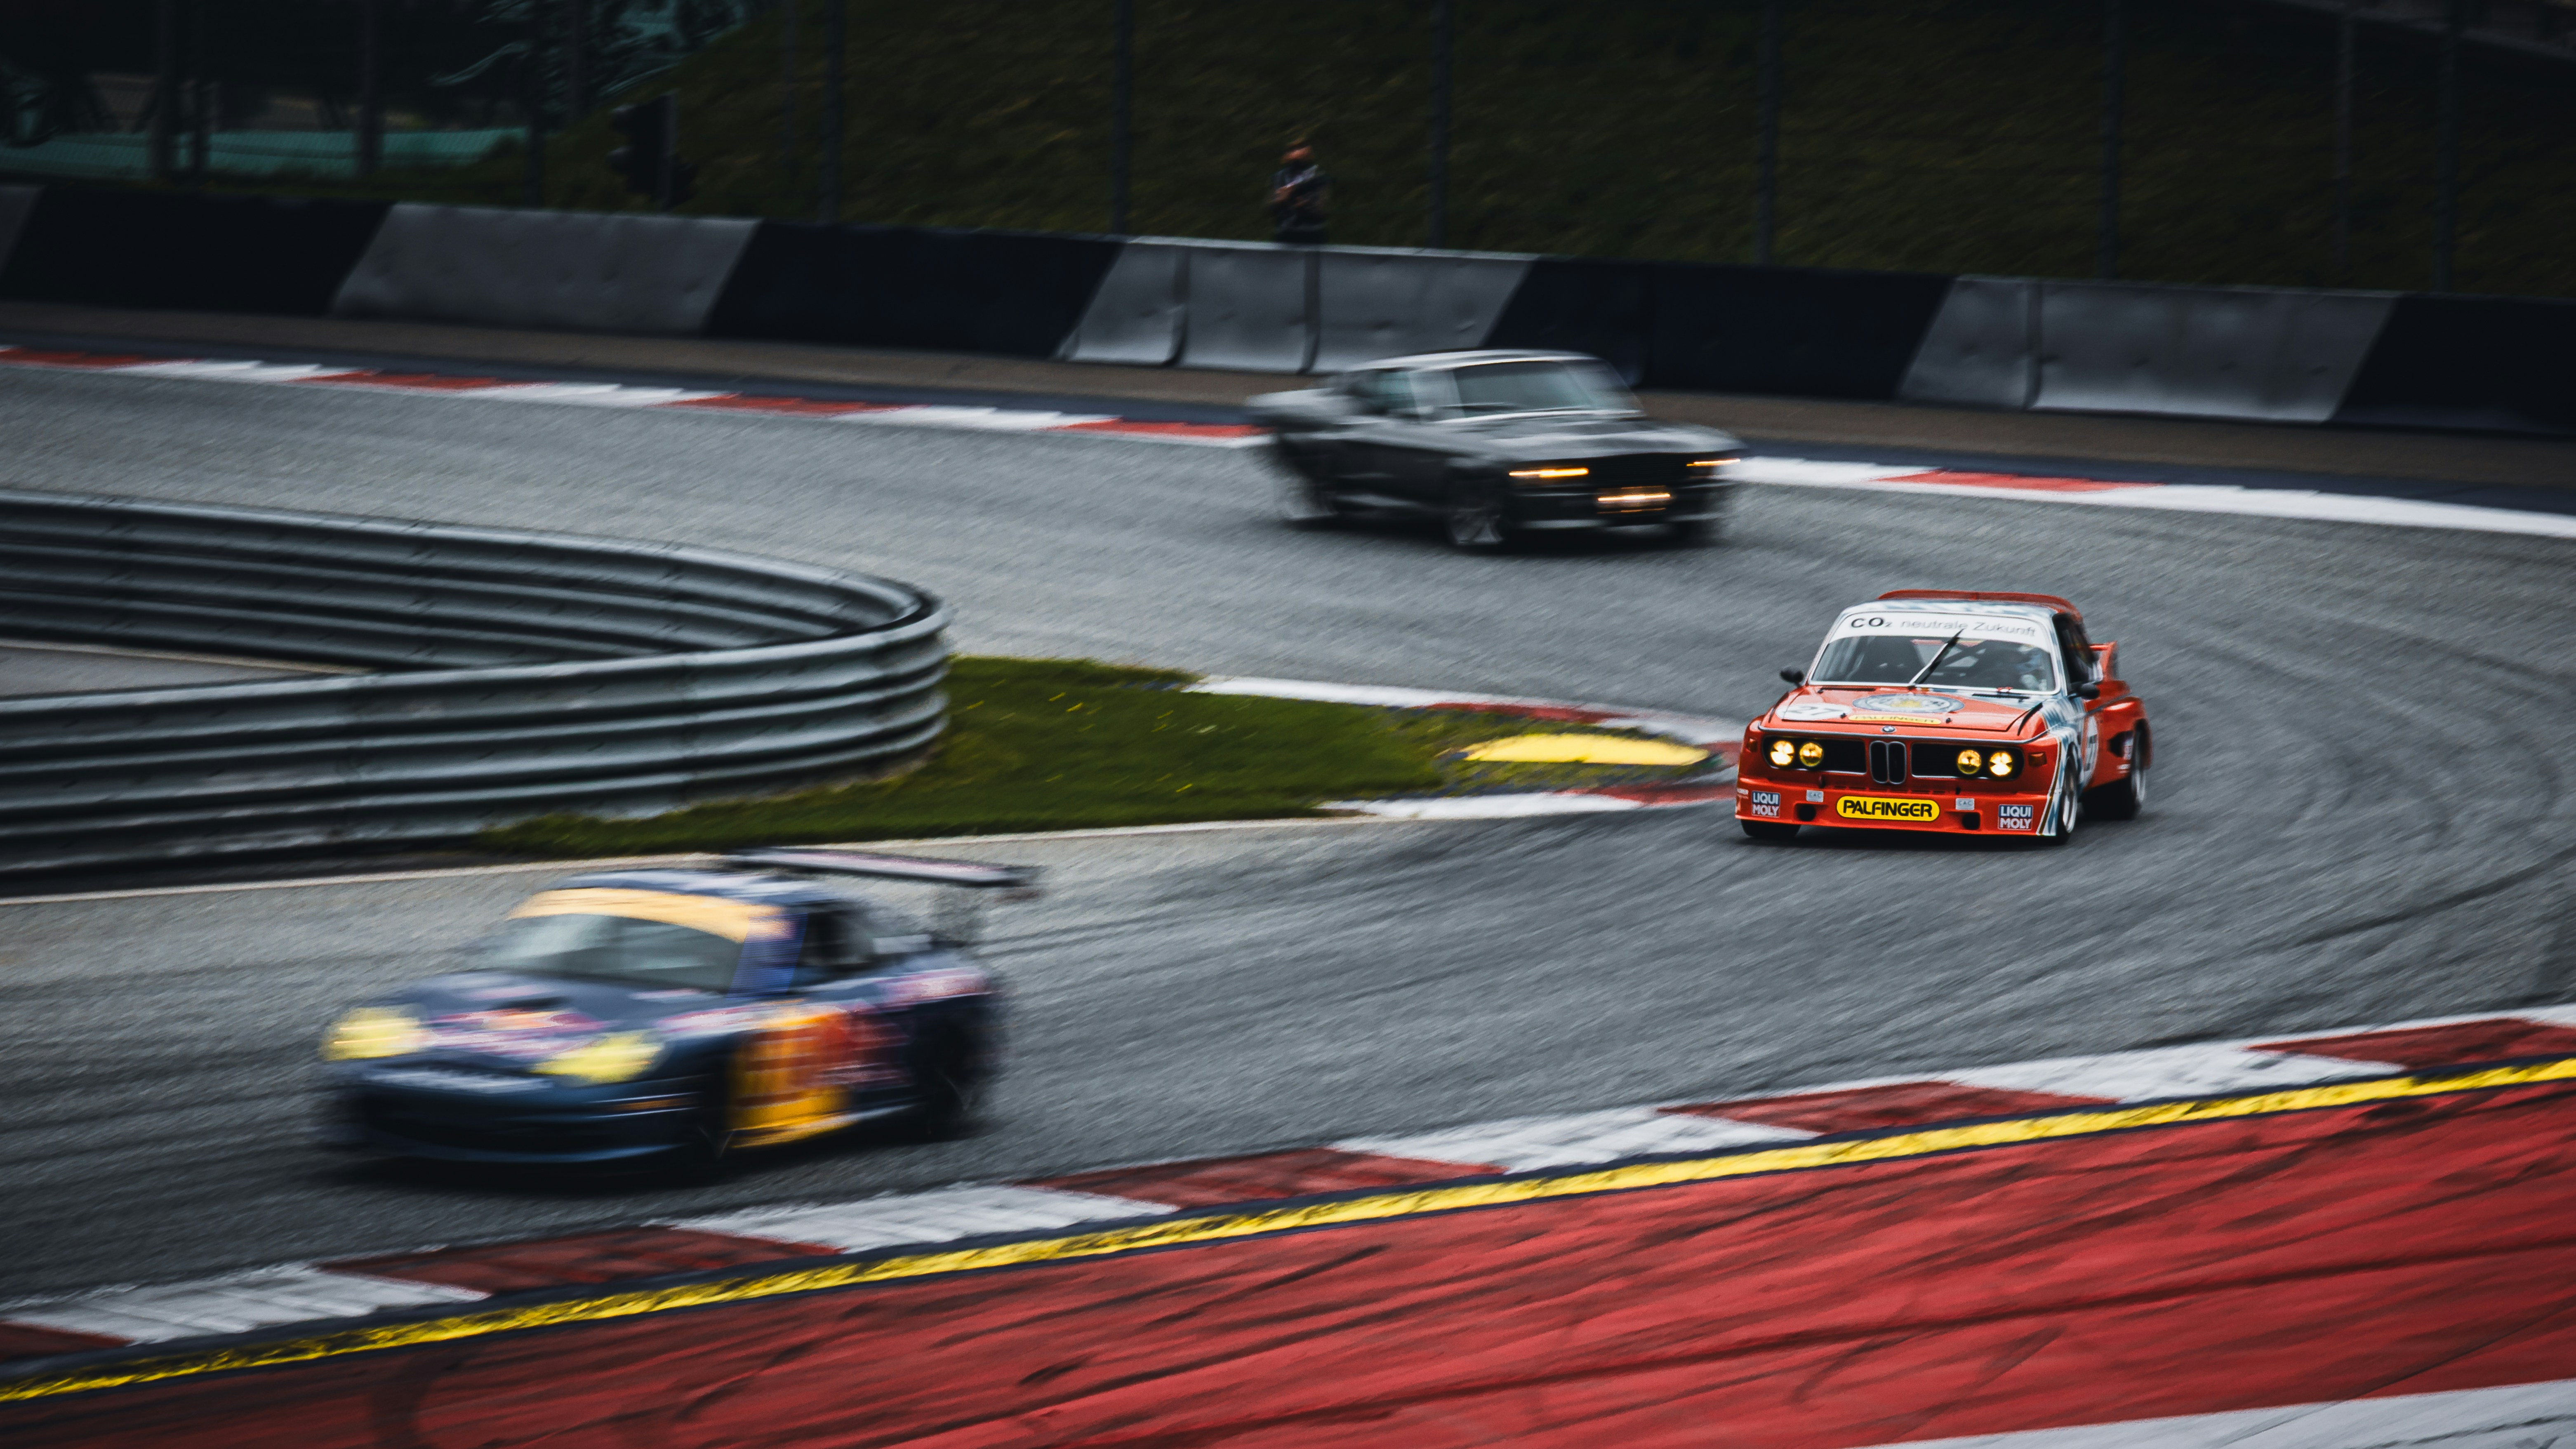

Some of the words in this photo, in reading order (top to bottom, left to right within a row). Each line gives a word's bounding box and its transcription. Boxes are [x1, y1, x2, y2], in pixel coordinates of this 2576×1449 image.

[1900, 619, 1968, 630] neutrale
[1972, 621, 2036, 637] Zukunft
[1753, 792, 1779, 805] LIQUI
[1752, 804, 1779, 816] MOLY
[1843, 799, 1932, 818] PALFINGER
[2001, 806, 2031, 818] LIQUI
[2000, 818, 2032, 829] MOLY
